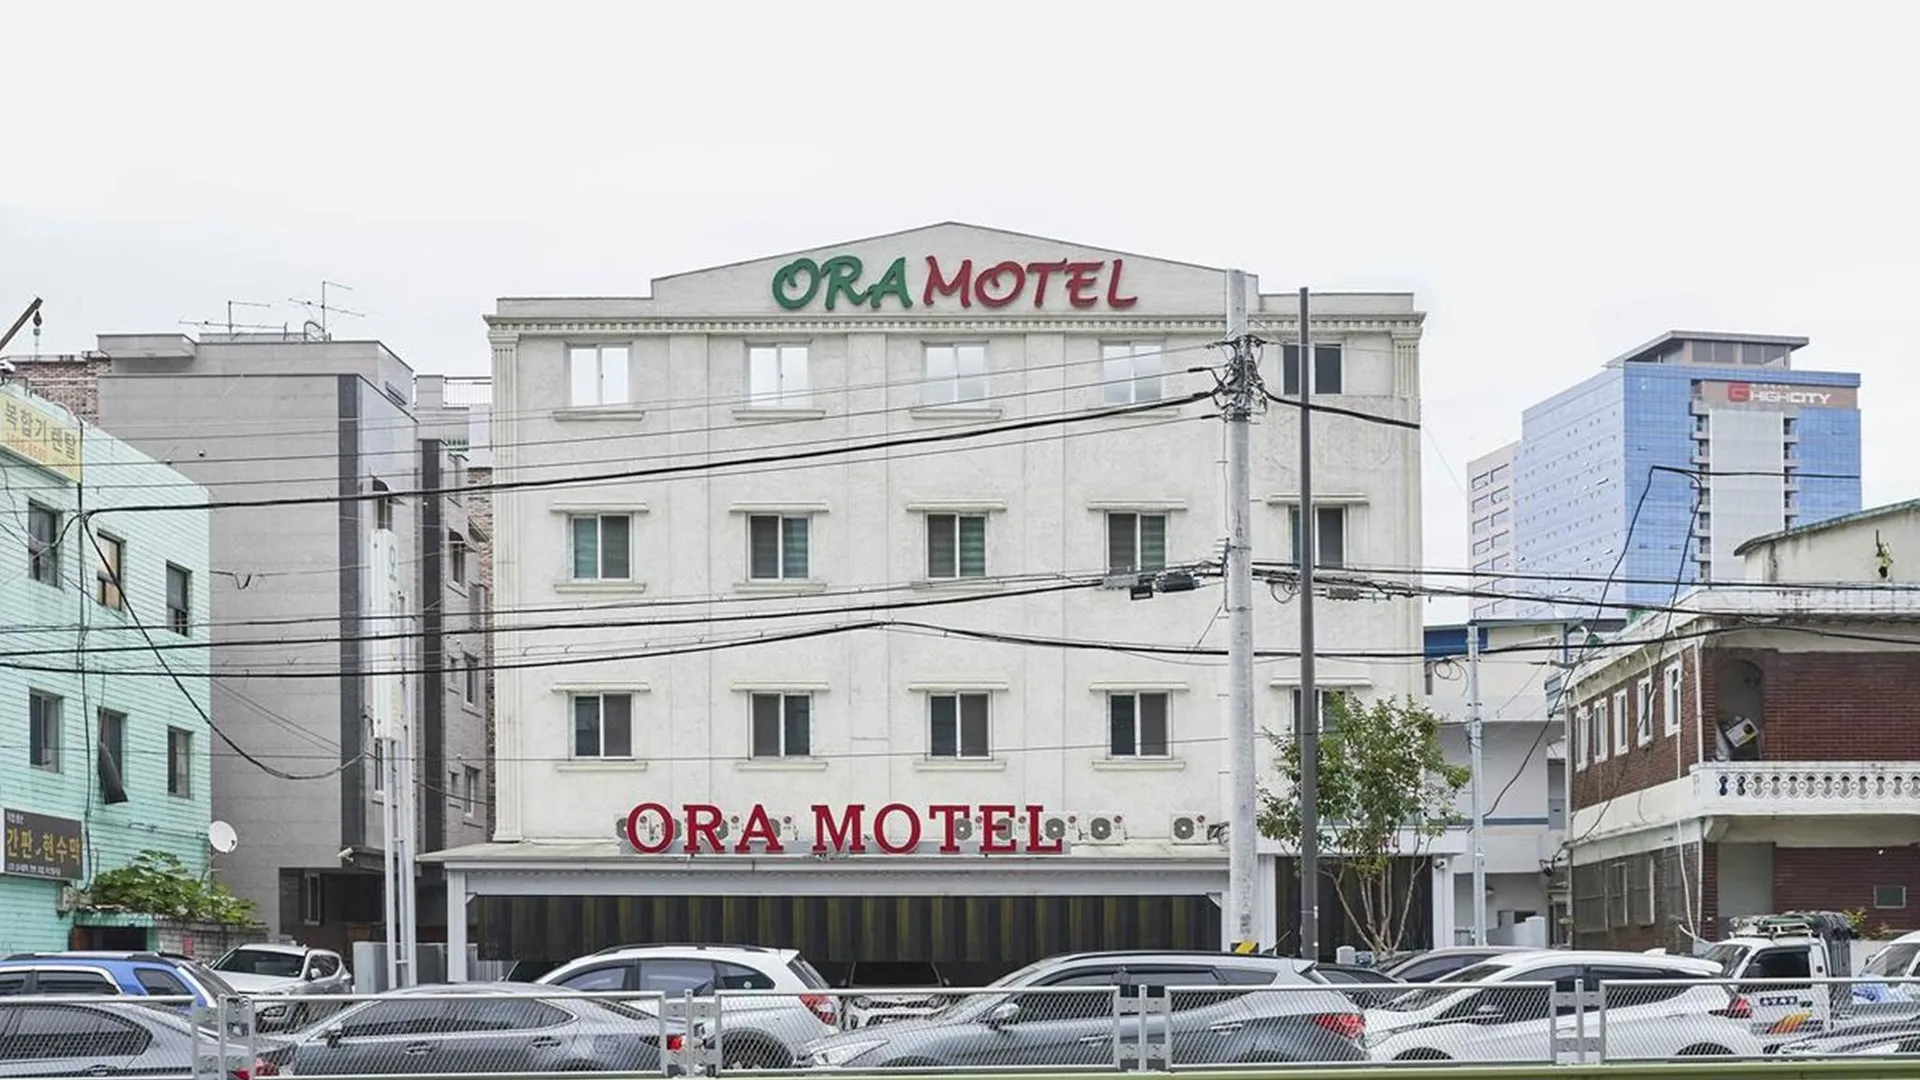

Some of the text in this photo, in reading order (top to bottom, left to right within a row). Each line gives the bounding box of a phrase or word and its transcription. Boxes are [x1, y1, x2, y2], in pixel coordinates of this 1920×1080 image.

[772, 254, 1139, 311] ORA MOTEL
[625, 802, 1064, 854] ORA MOTEL
